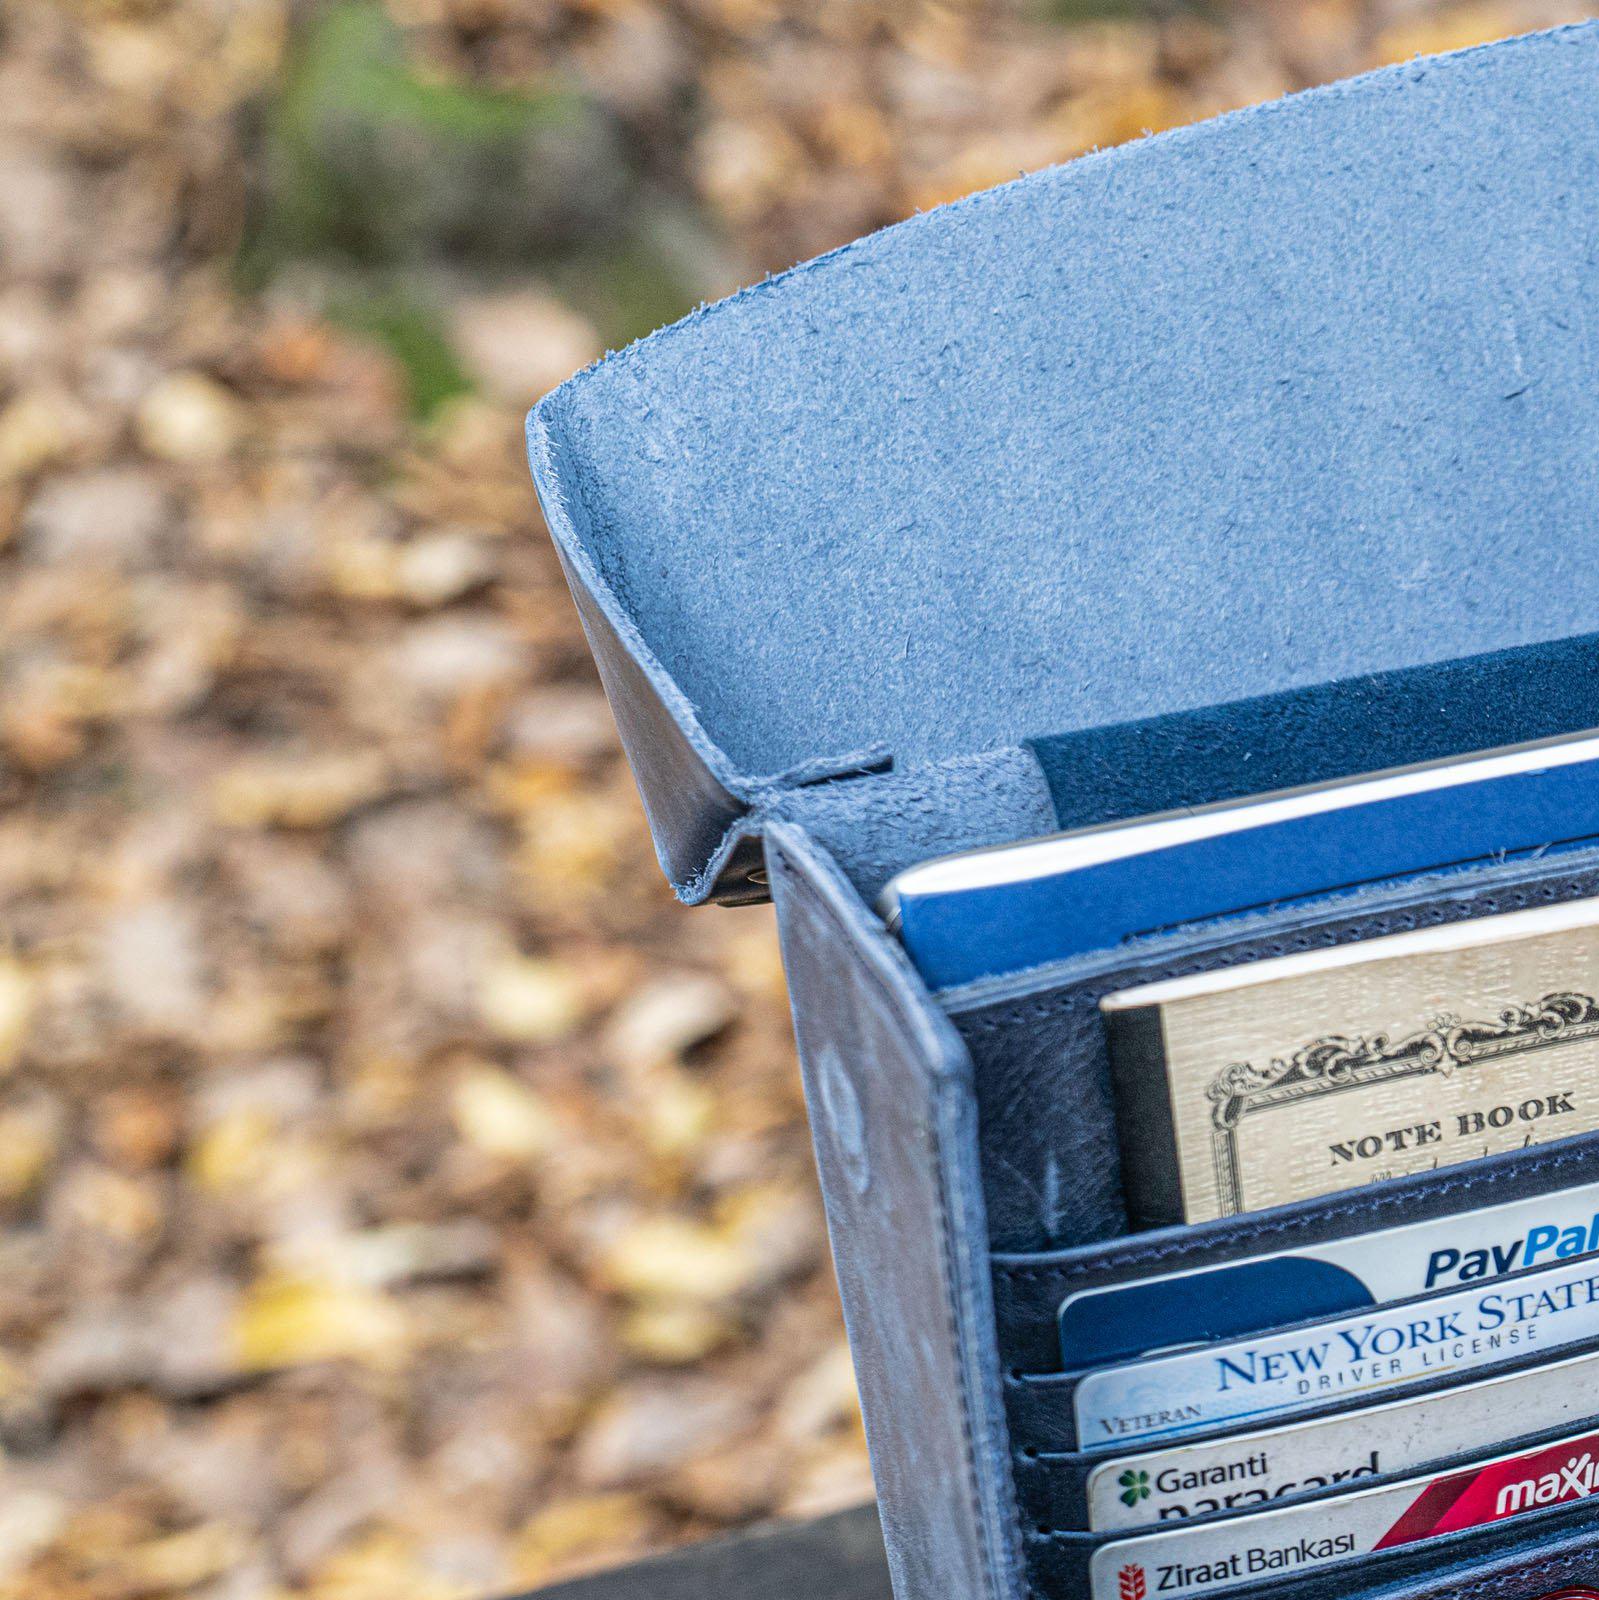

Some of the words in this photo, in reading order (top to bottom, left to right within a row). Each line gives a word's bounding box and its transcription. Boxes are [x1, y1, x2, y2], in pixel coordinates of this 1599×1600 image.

[1329, 1120, 1443, 1166] NOTE
[1456, 1091, 1576, 1137] BOOK
[1215, 1343, 1331, 1393] NEW
[1336, 1311, 1472, 1363] YORK
[1298, 1358, 1402, 1396] DRIVER
[1423, 1320, 1538, 1368] LICENSE
[1099, 1403, 1202, 1435] VETERAN
[1156, 1452, 1268, 1494] Garanti
[1156, 1553, 1241, 1591] Ziraat
[1248, 1533, 1355, 1573] Bankası
